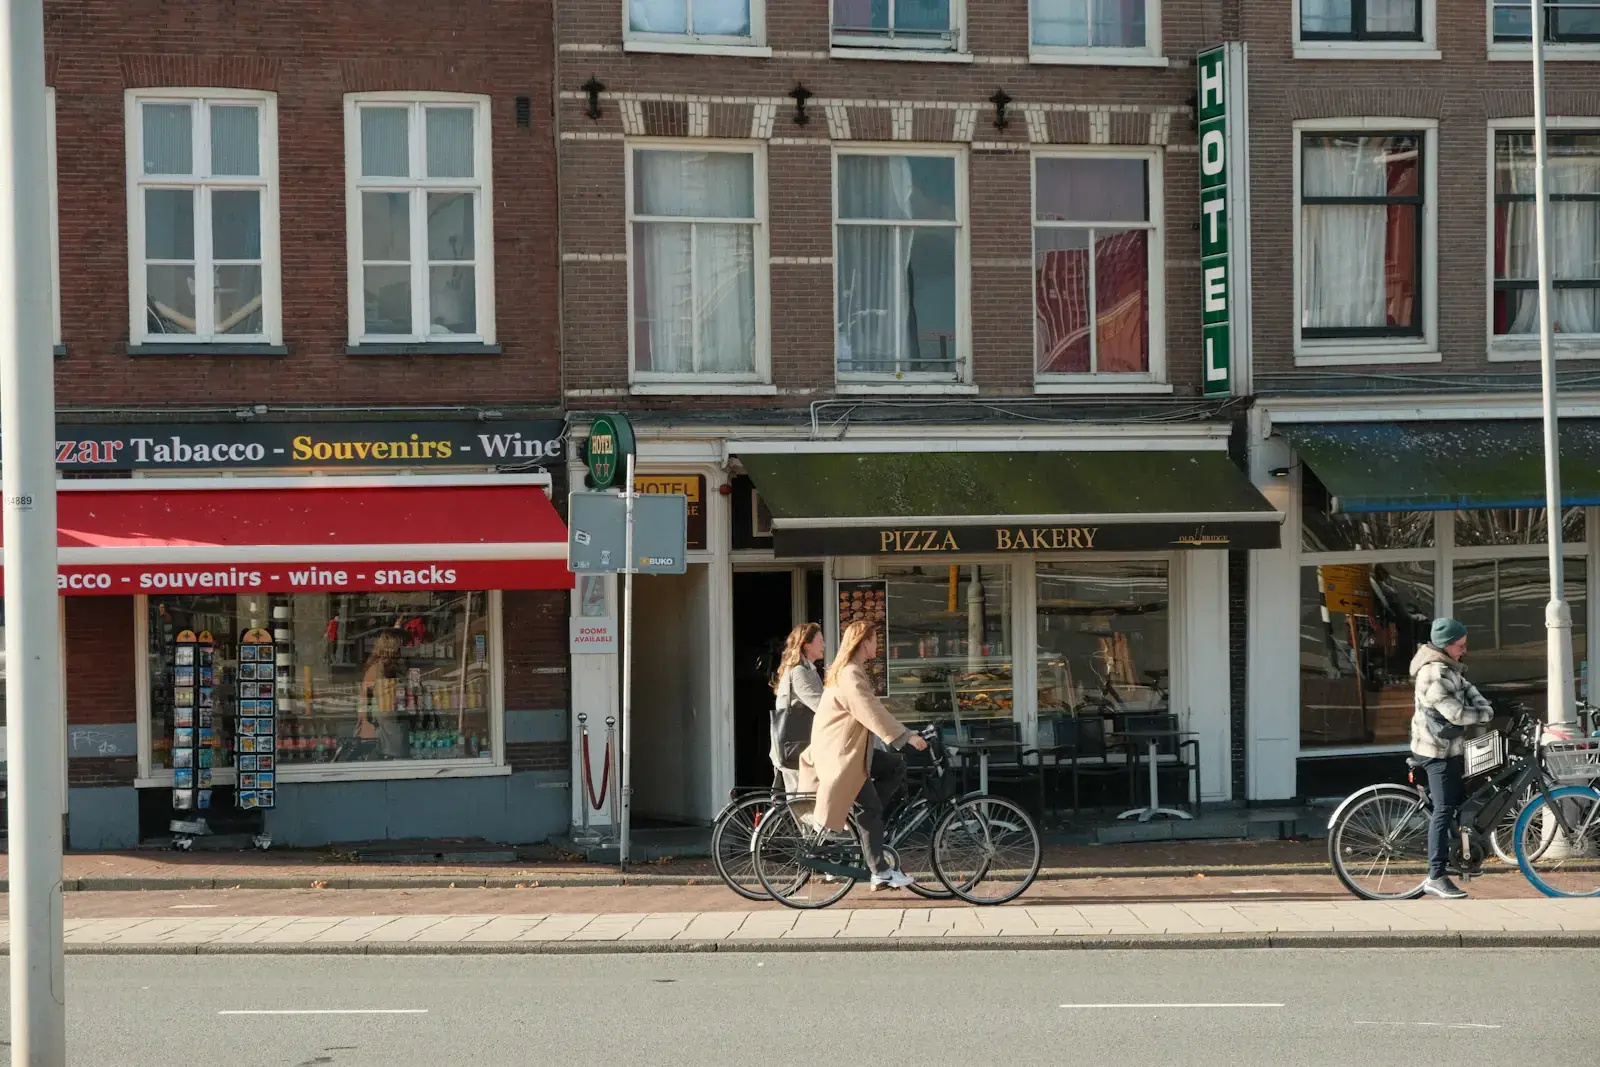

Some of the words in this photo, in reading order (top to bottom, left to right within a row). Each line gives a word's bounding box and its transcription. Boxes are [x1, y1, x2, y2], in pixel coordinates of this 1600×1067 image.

[1201, 61, 1227, 381] HOTEL
[56, 440, 123, 463] zar
[130, 436, 265, 462] Tabacco
[293, 433, 452, 460] Souvenirs
[478, 432, 561, 458] Wine
[592, 435, 613, 454] HOTEL
[634, 483, 694, 496] HOTEL
[880, 530, 960, 552] PIZZA
[996, 528, 1098, 549] BAKERY
[57, 573, 111, 589] acco
[140, 568, 261, 588] souvenirs
[288, 567, 348, 586] wine
[374, 565, 457, 584] snacks
